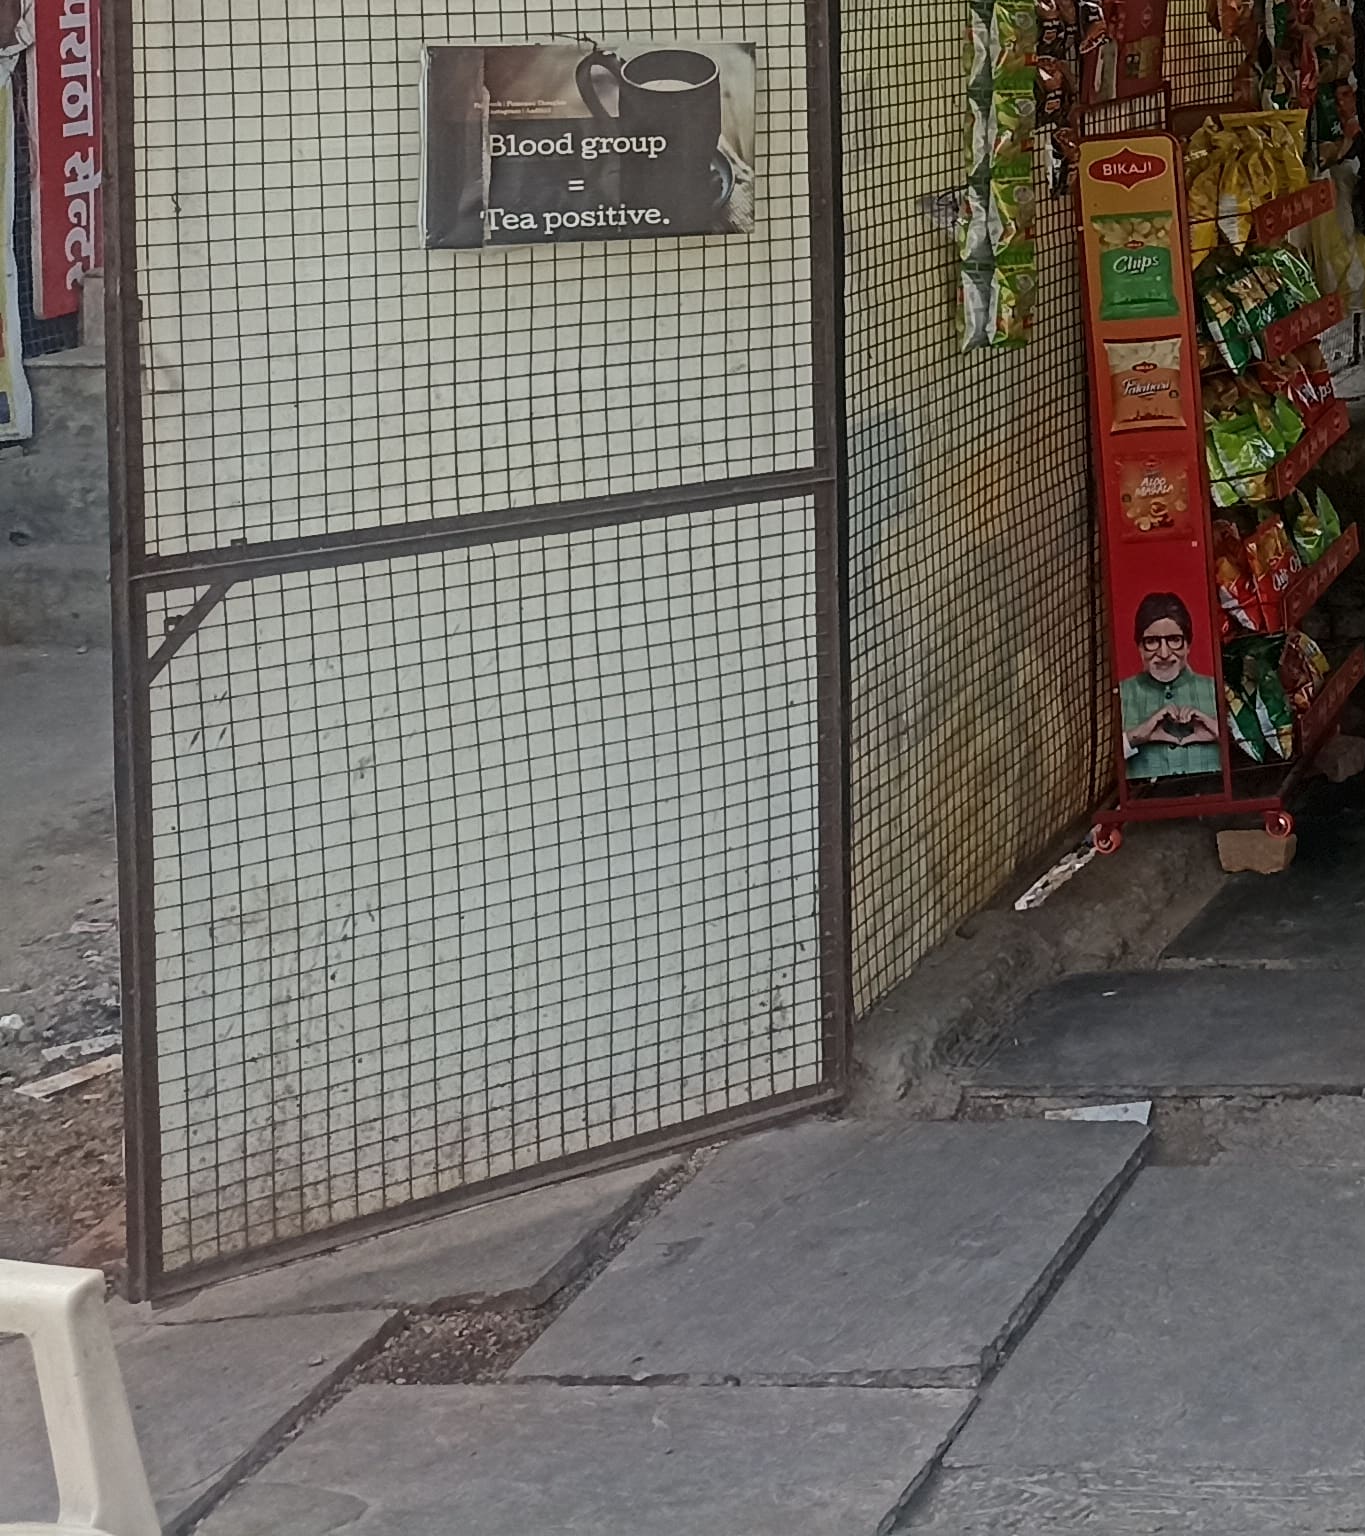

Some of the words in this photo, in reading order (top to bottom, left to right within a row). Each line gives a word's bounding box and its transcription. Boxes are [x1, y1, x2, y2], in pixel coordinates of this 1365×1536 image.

[489, 133, 573, 156] Blood
[581, 136, 666, 159] group
[1103, 162, 1152, 175] BIKAJI
[480, 208, 537, 231] Tea
[544, 204, 670, 234] positive.
[1113, 255, 1159, 273] Chips
